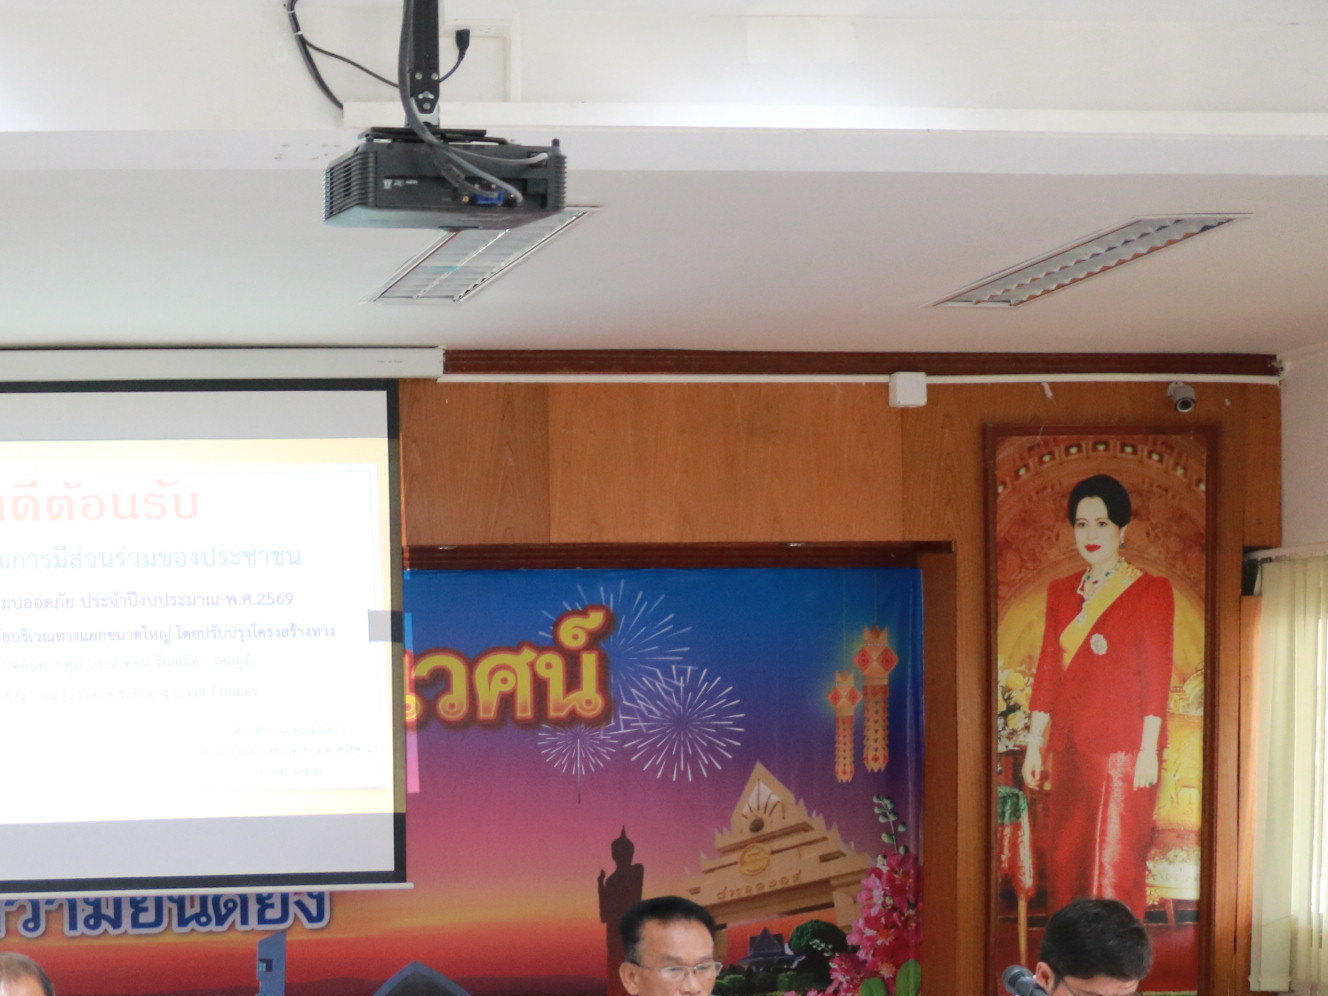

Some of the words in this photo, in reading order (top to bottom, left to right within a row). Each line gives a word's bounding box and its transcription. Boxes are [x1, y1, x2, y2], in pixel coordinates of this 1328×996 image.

[80, 590, 219, 609] ประจำปีงบประมาณ
[226, 592, 295, 607] พ.ศ.2569
[175, 621, 336, 644] โดยปรับปรุงโครงสร้างทาง
